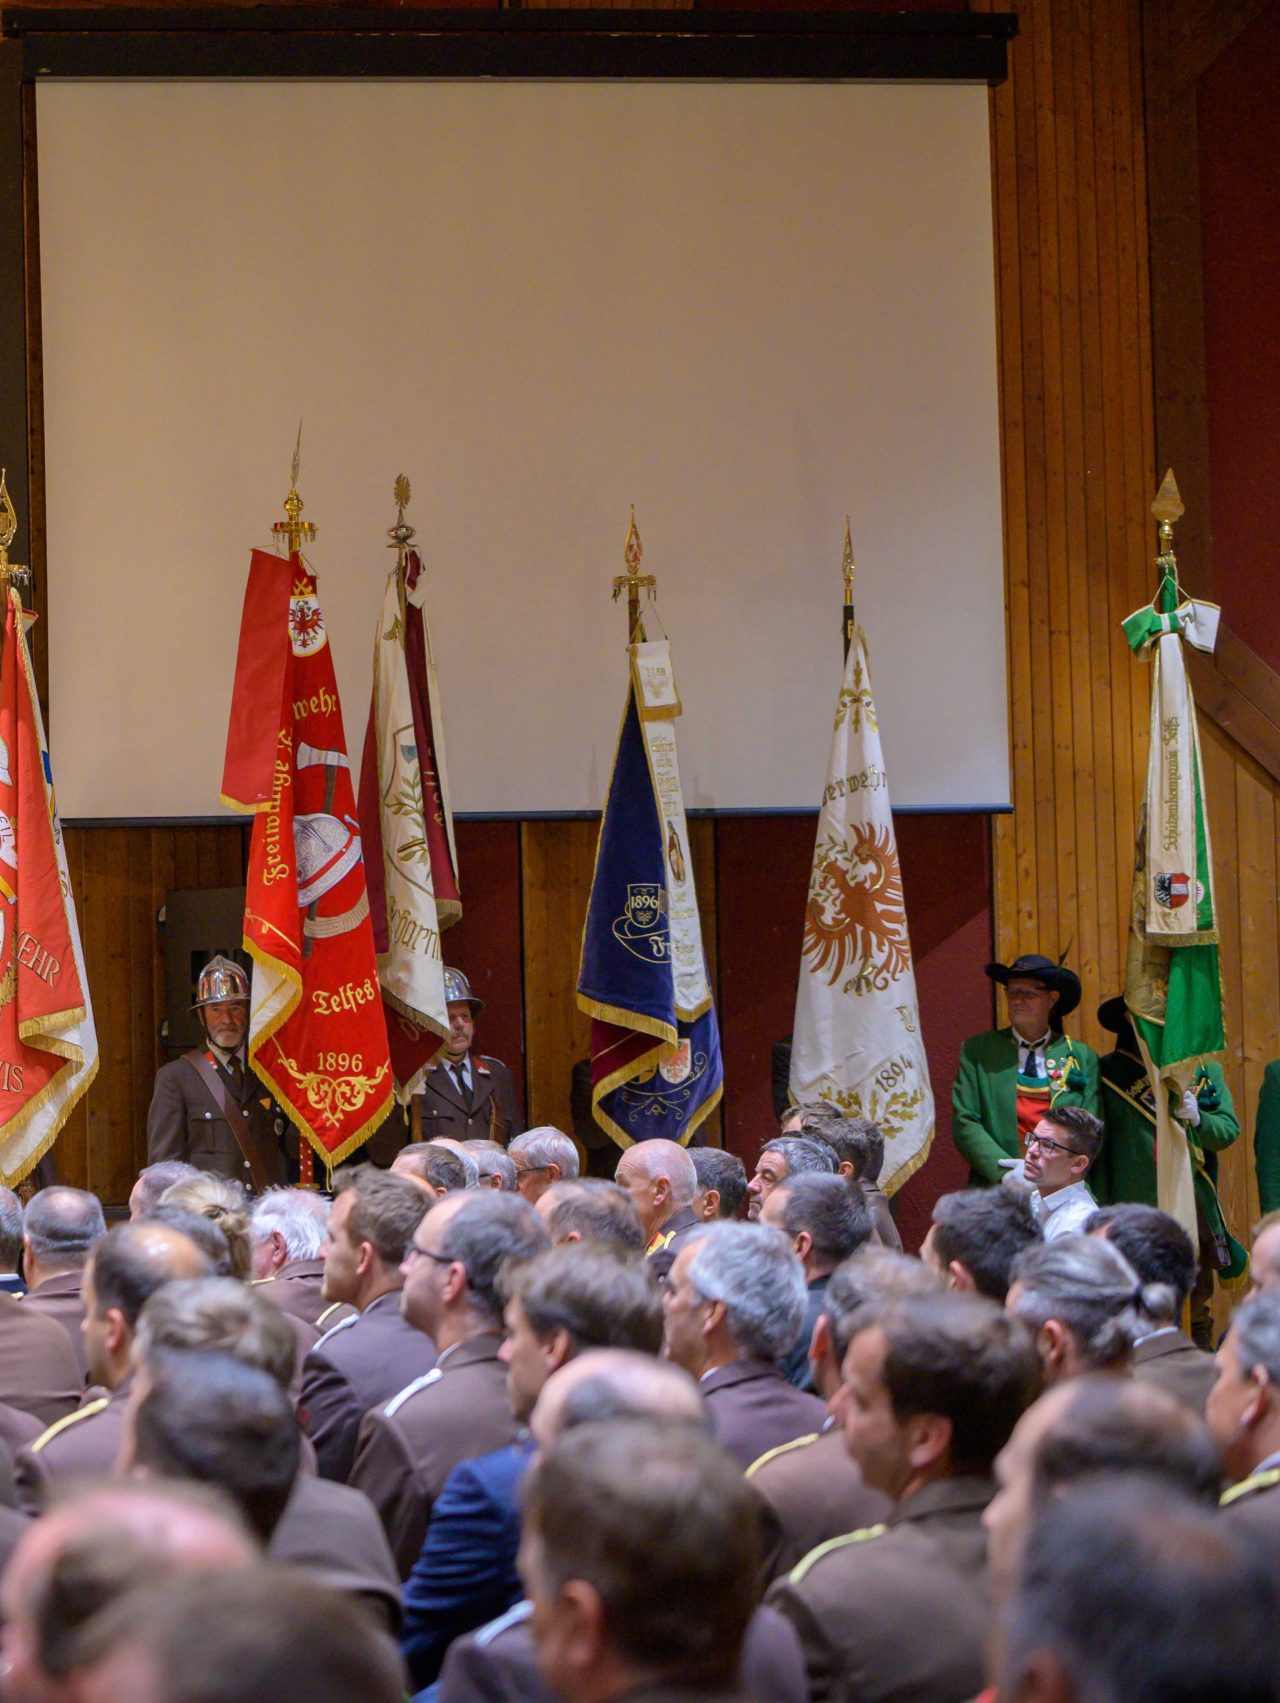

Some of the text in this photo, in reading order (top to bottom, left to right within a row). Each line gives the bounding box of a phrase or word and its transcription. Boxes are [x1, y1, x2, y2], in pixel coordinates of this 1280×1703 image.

[631, 895, 659, 909] 1896
[312, 978, 375, 1015] Telfes
[316, 1052, 363, 1073] 1896
[875, 1054, 913, 1093] 1894
